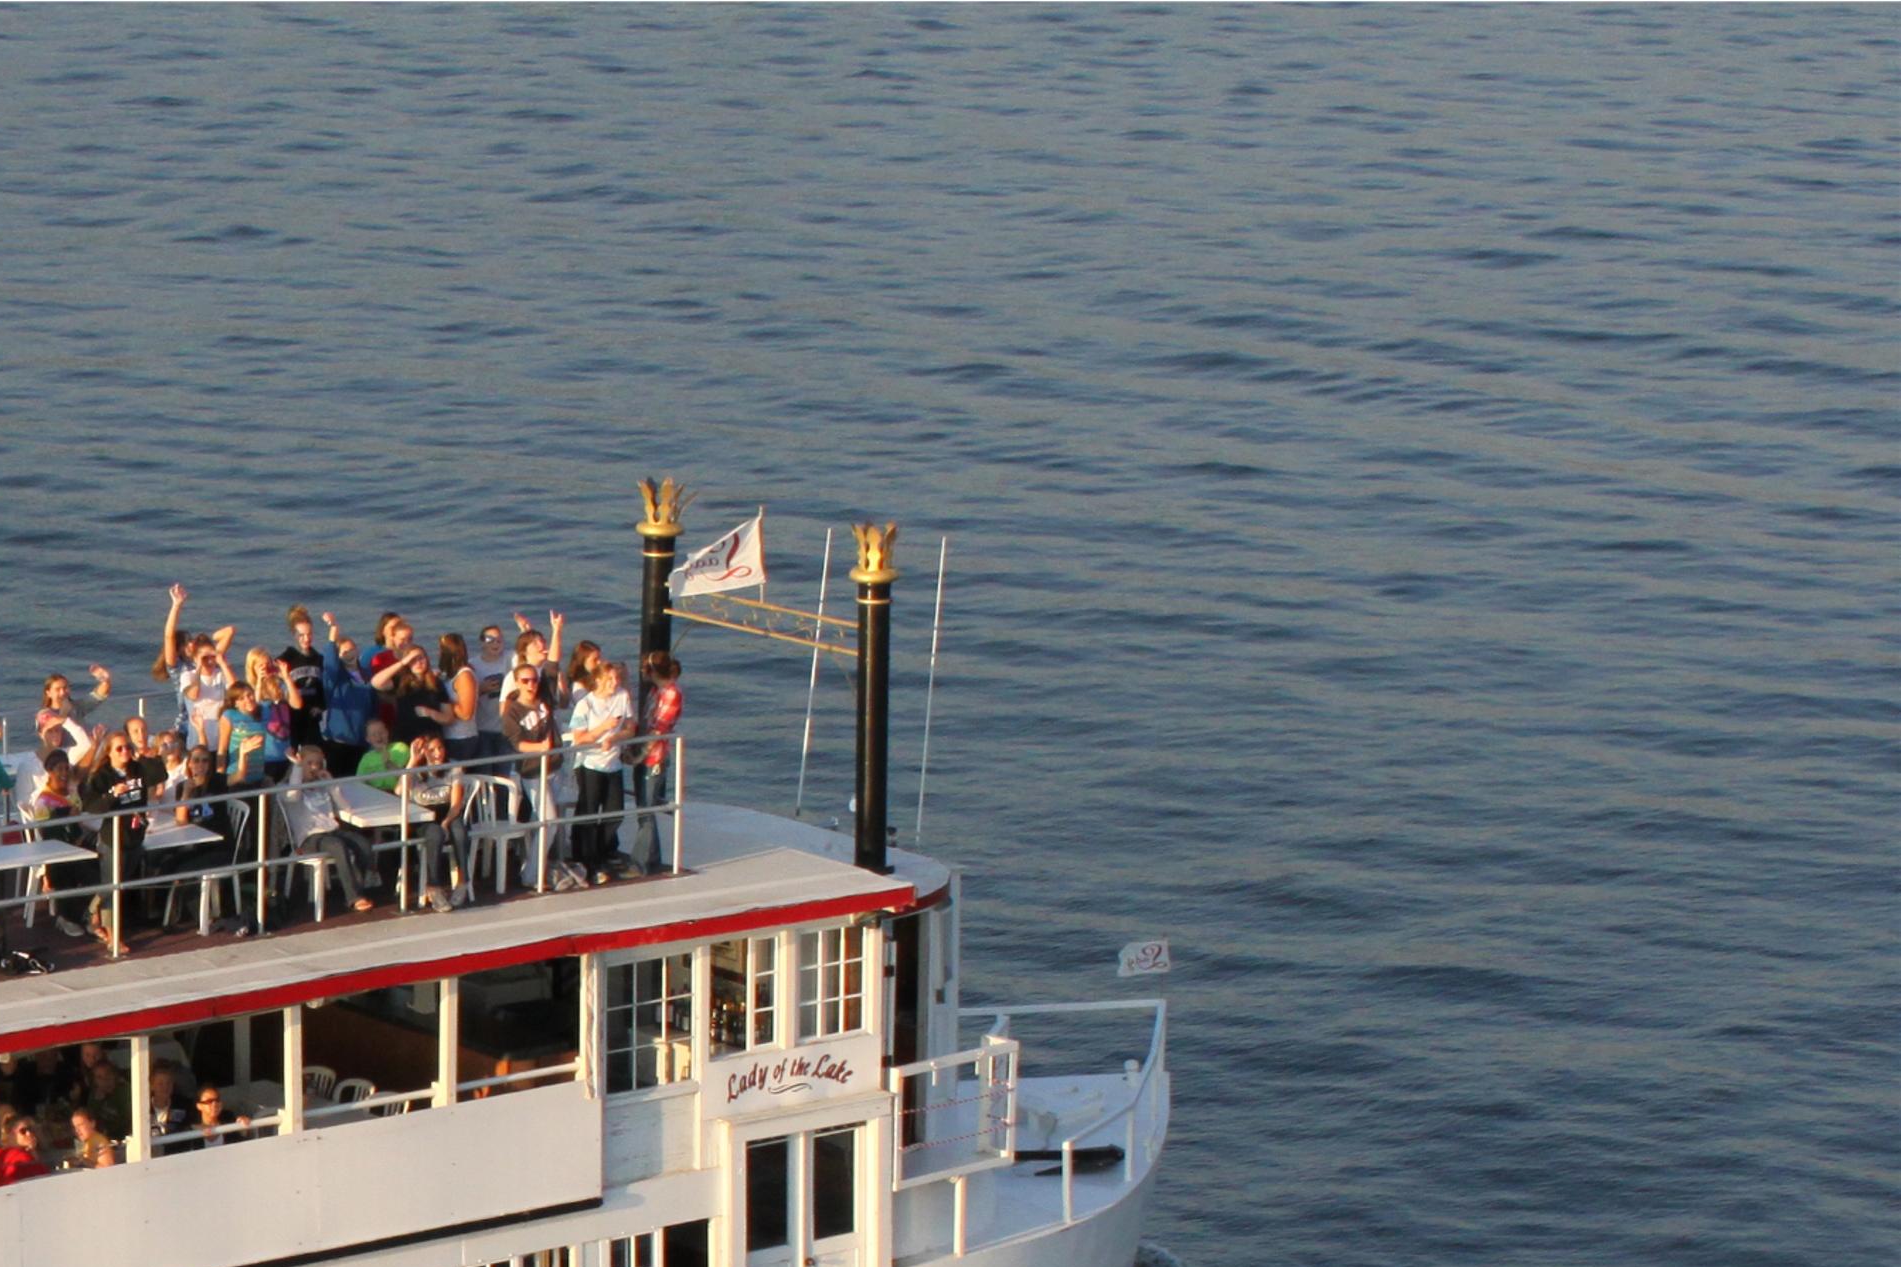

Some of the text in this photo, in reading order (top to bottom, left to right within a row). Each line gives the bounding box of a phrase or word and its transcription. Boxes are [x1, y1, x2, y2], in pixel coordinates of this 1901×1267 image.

[727, 1054, 853, 1103] Lady of the Lake
